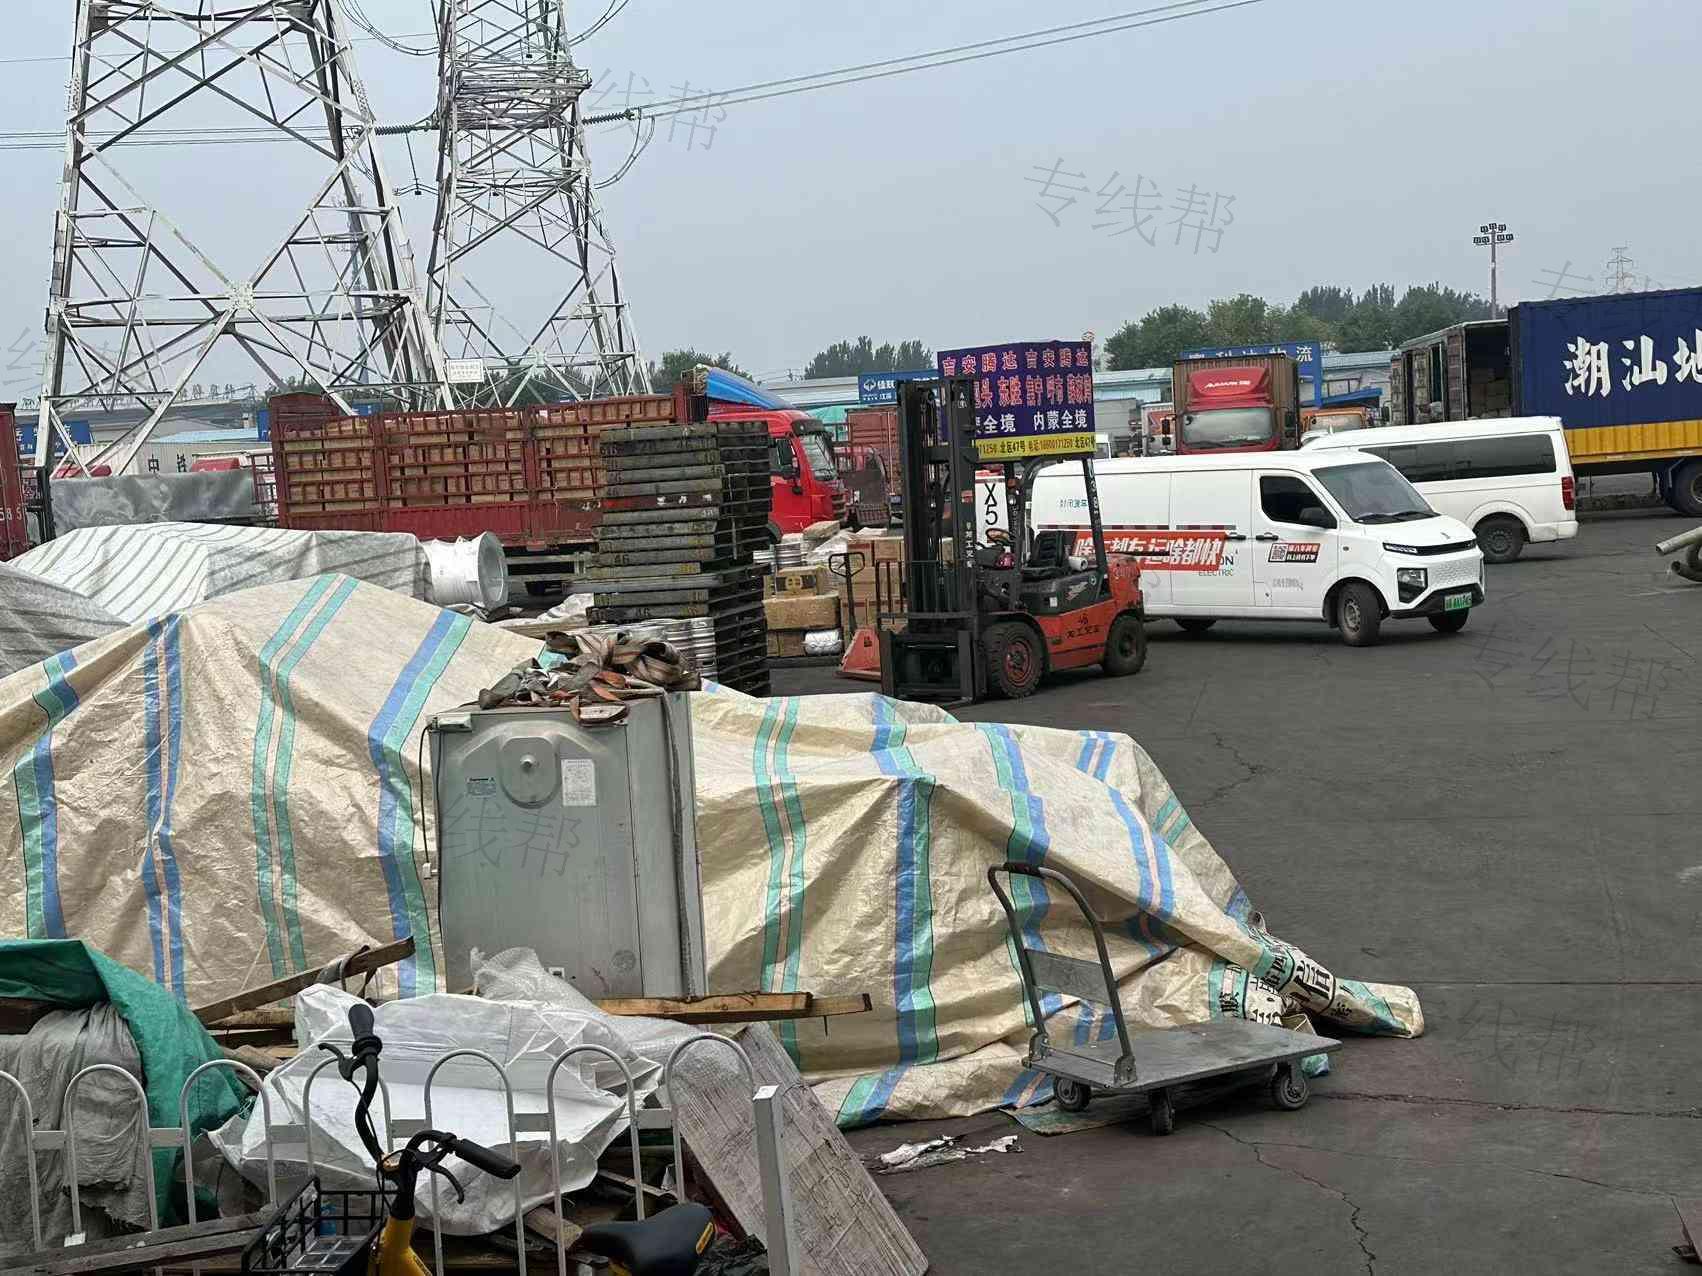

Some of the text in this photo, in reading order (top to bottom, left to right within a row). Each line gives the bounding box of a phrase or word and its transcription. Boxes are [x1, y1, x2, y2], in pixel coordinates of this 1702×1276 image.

[1563, 328, 1702, 397] 潮汕地
[1033, 409, 1088, 431] 内蒙全境
